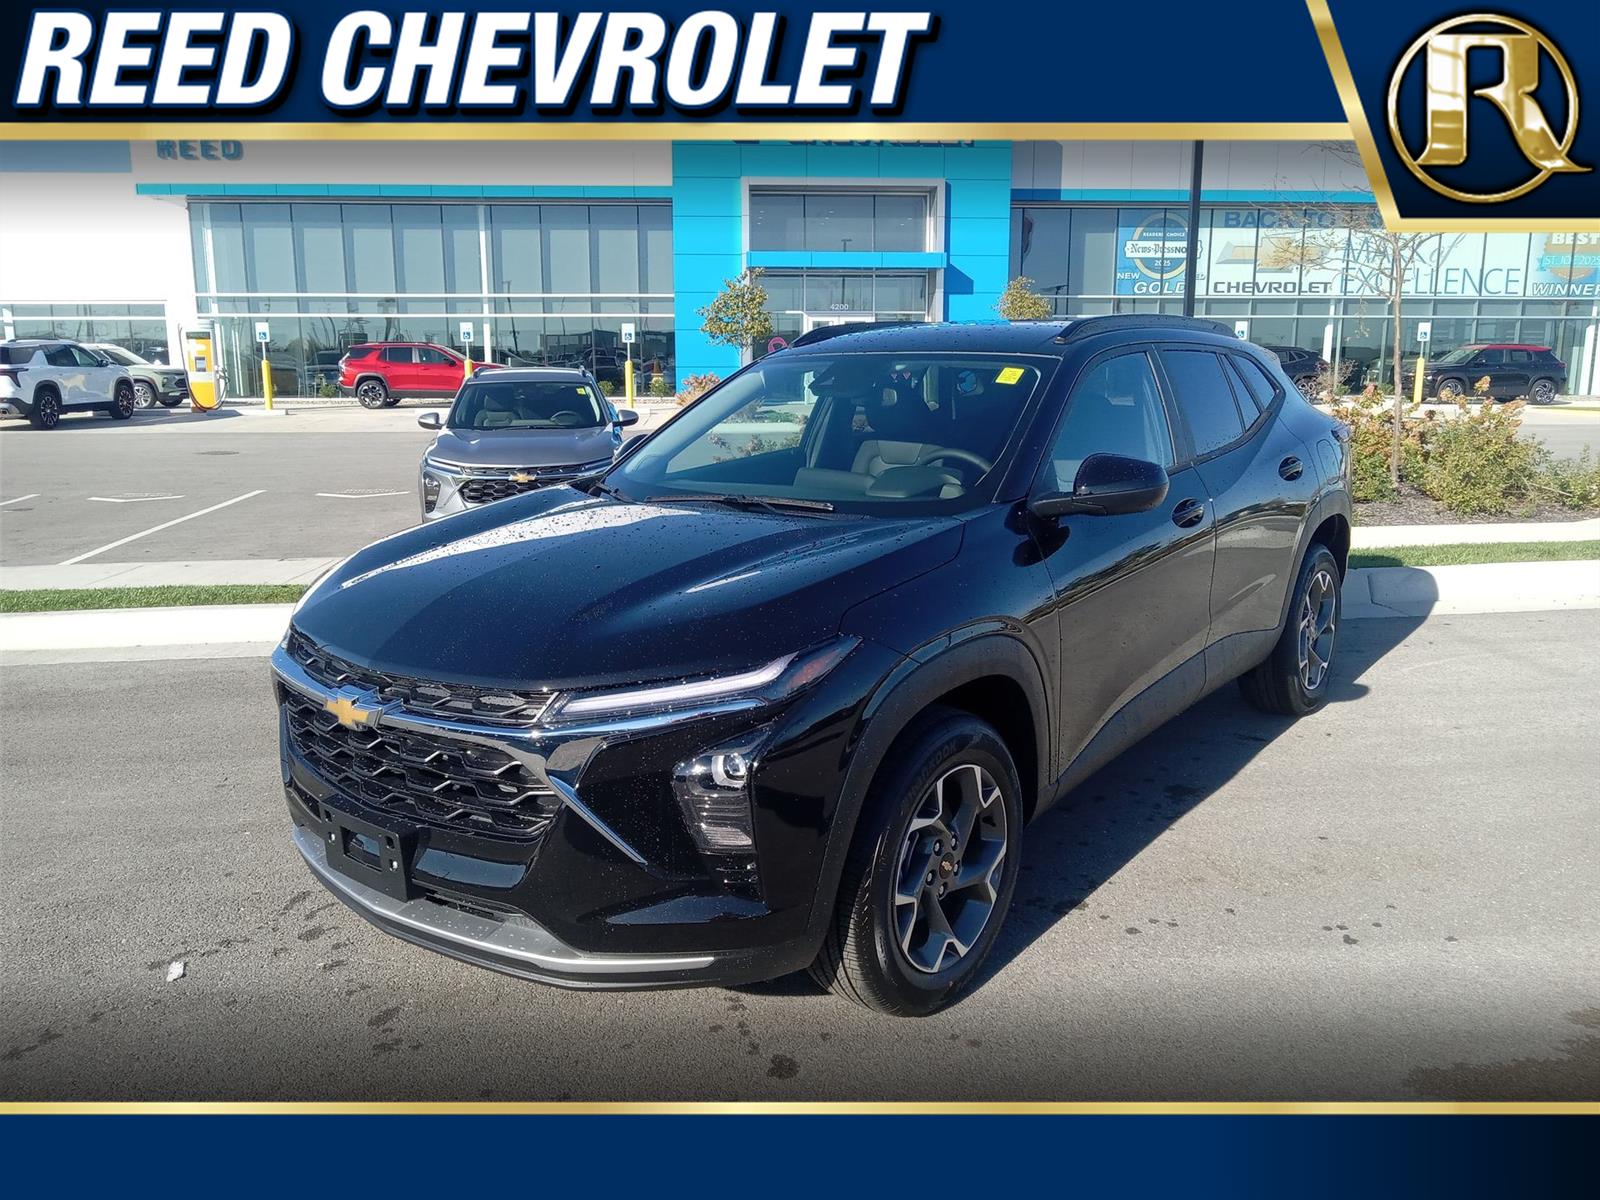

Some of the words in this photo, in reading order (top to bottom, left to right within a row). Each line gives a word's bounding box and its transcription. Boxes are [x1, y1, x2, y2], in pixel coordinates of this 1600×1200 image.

[156, 140, 243, 160] REED
[1117, 272, 1140, 280] NEW
[1133, 281, 1185, 294] GOLD
[1213, 281, 1331, 294] CHEVROLET
